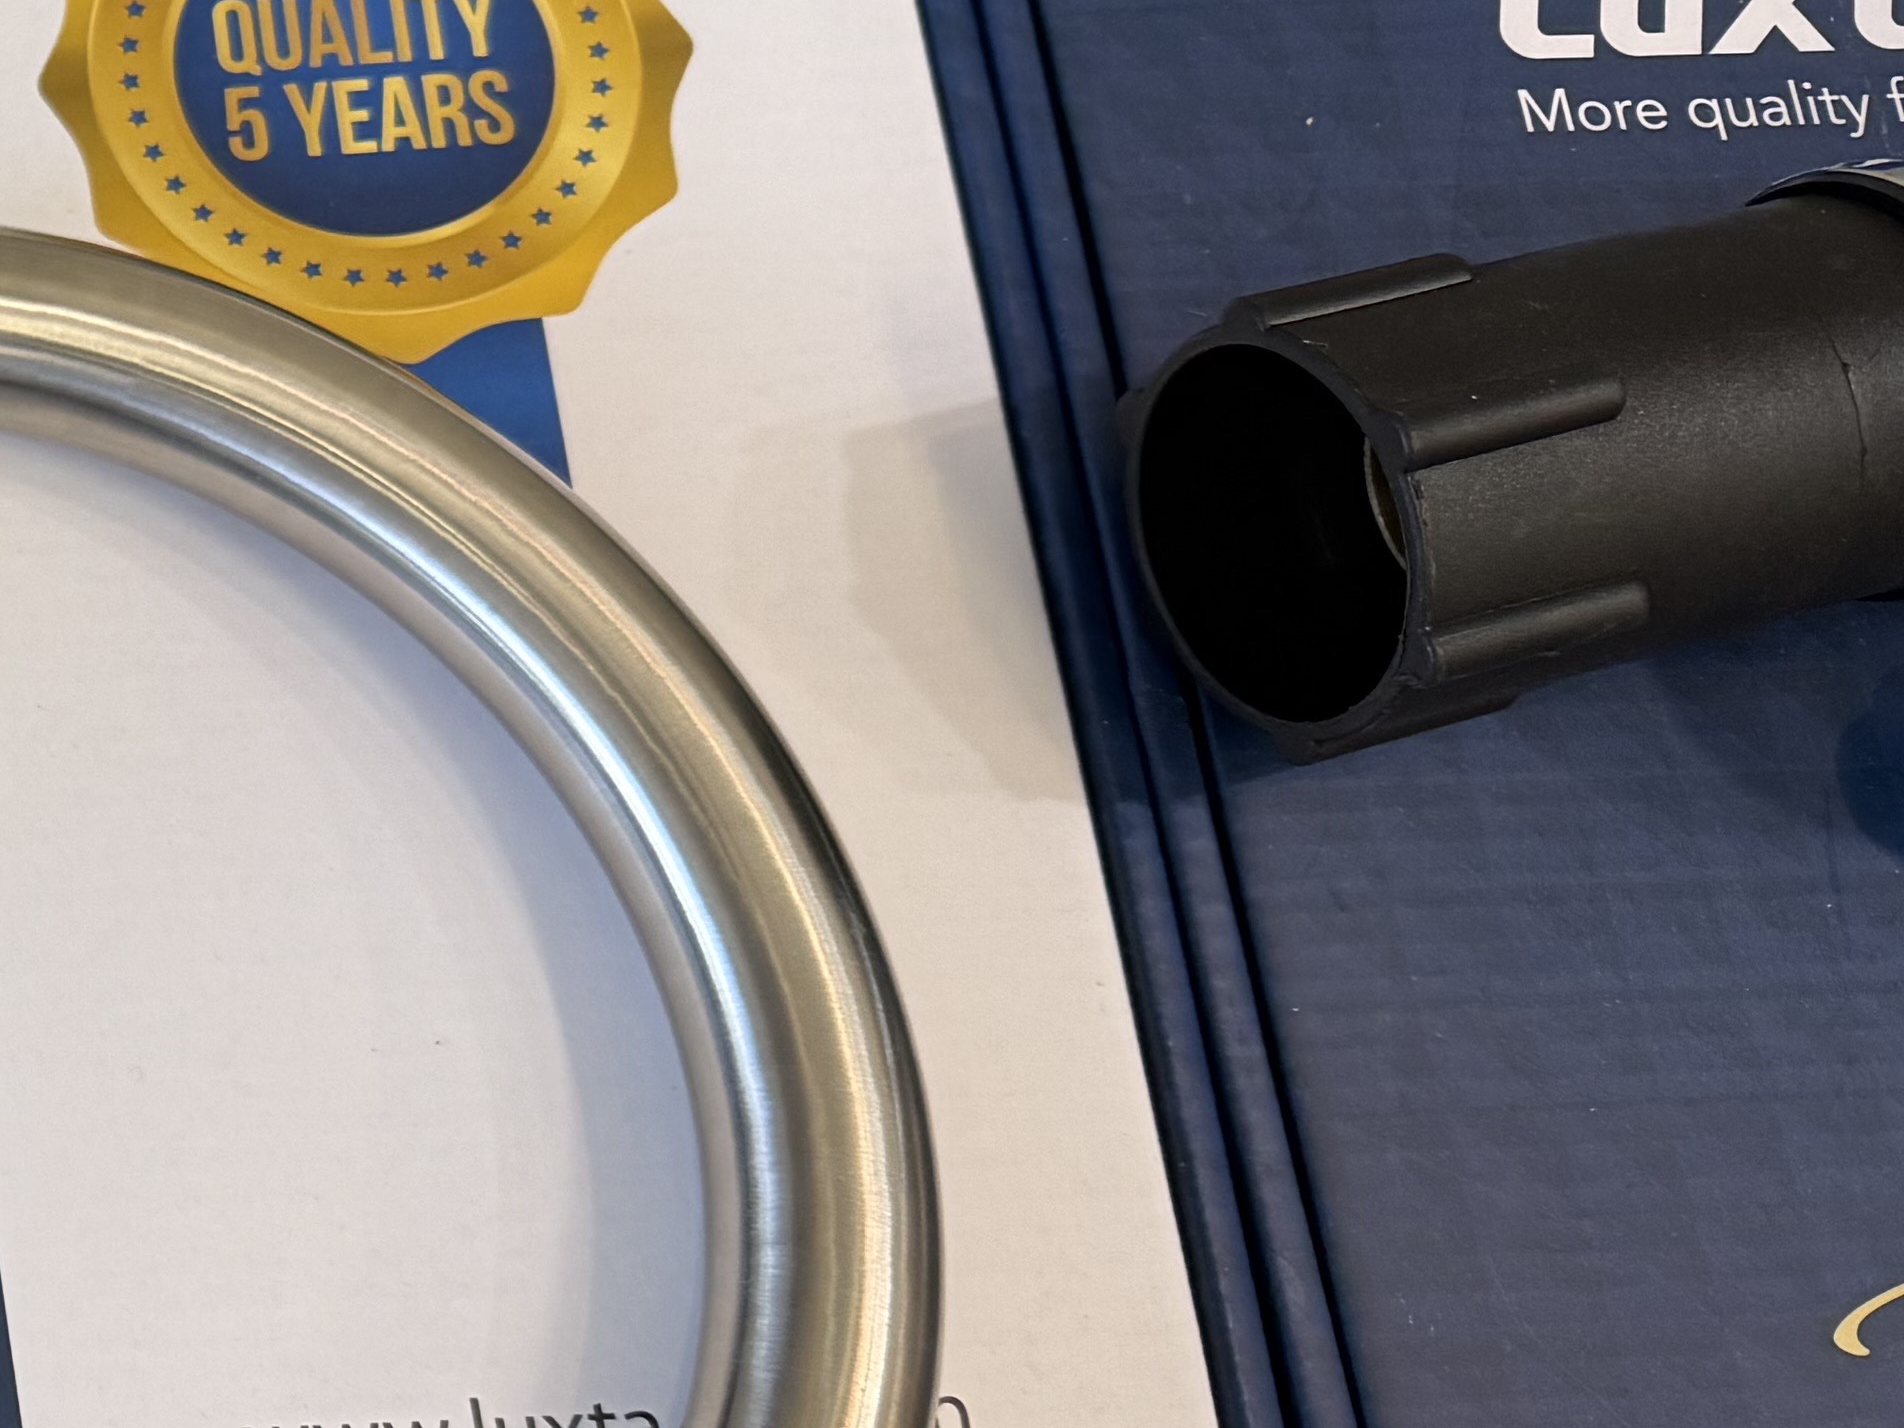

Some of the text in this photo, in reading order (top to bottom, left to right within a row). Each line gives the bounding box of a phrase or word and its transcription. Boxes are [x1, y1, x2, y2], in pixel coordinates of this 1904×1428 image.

[222, 70, 516, 162] 5 YEARS
[1516, 88, 1668, 132] More
[1688, 79, 1870, 141] quality
